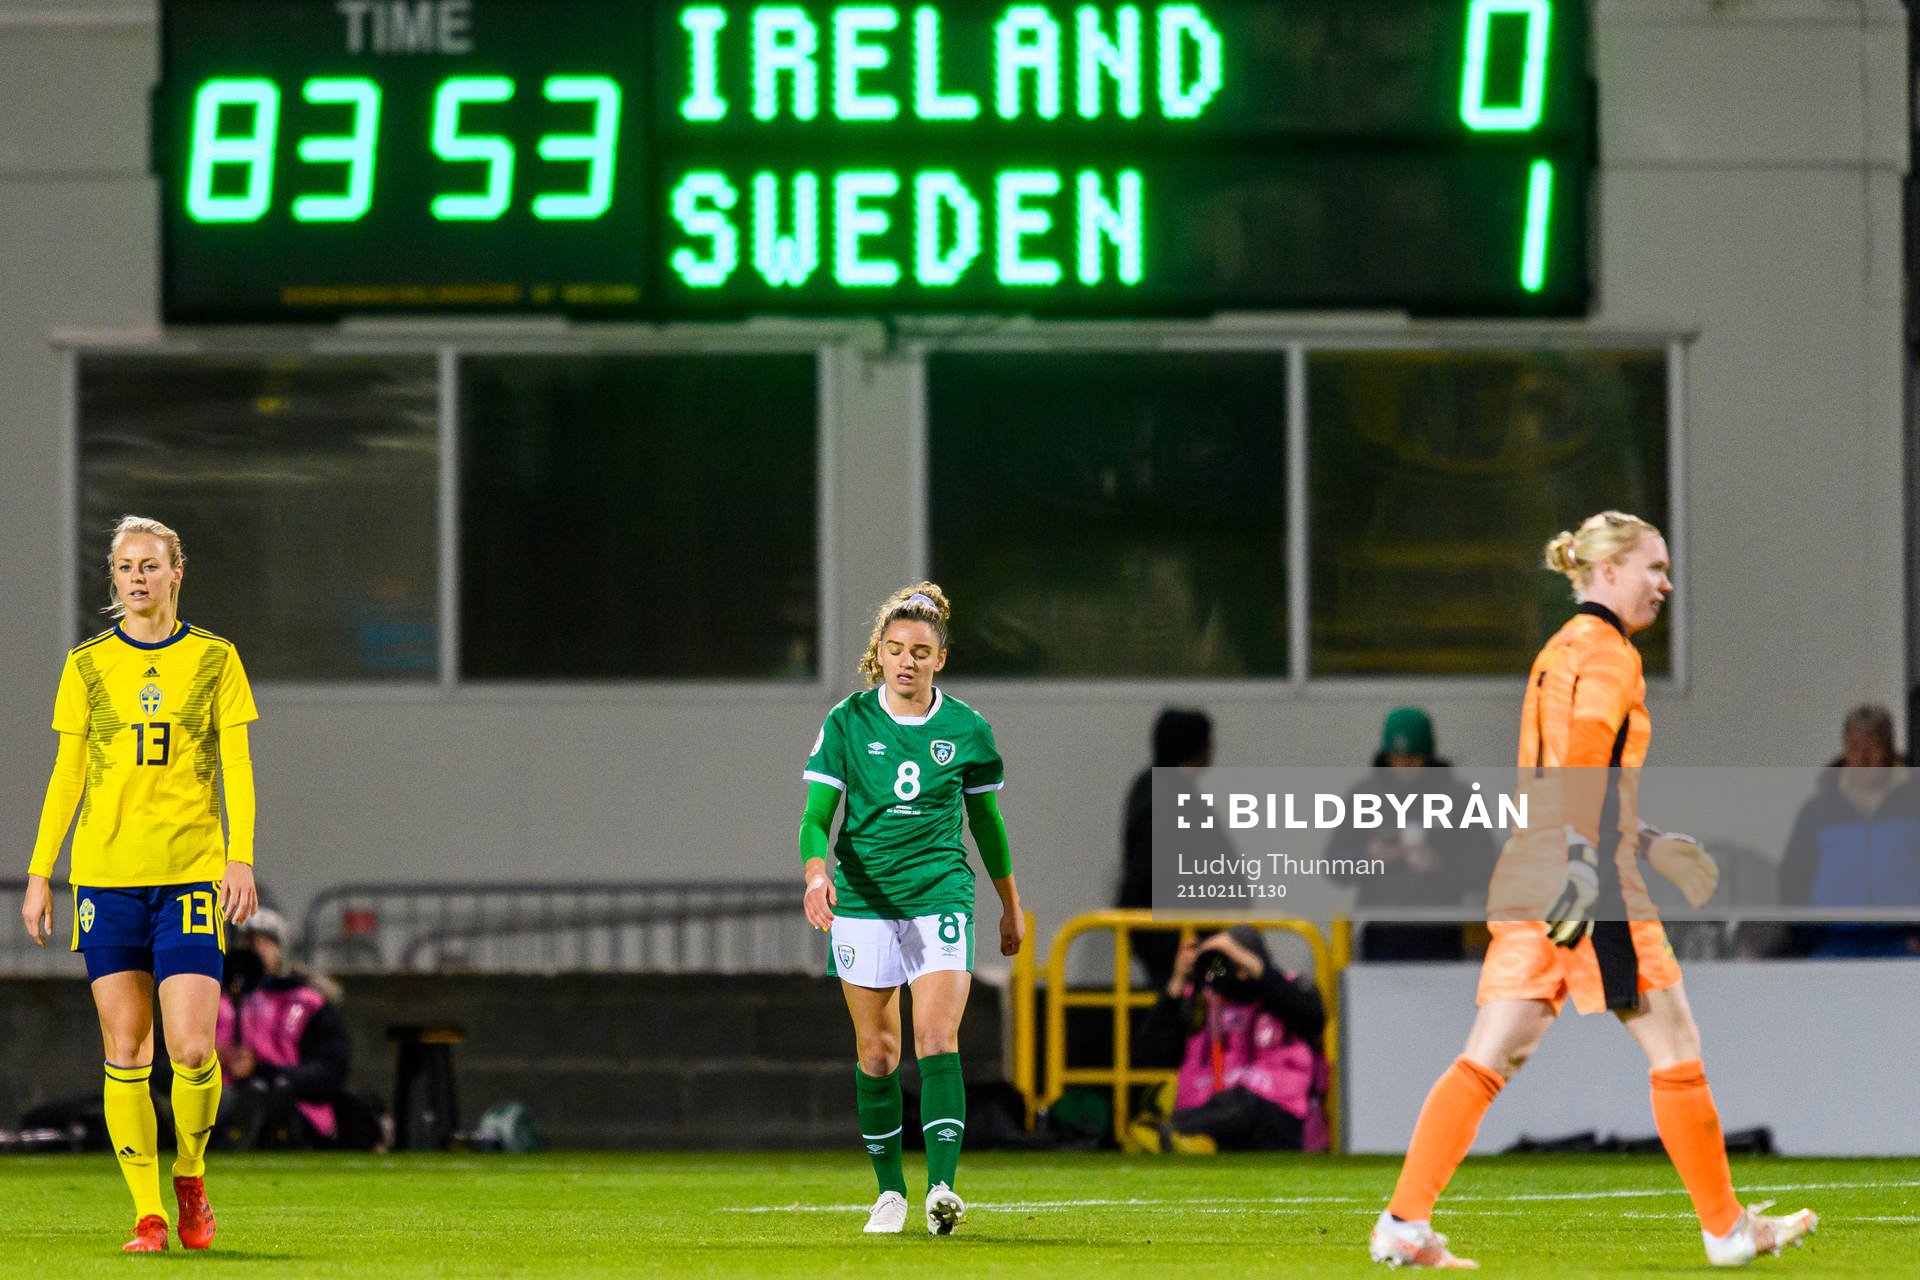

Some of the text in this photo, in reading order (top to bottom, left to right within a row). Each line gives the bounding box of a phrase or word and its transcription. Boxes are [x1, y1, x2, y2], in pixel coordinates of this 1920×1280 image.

[338, 0, 472, 53] TIME
[678, 2, 1225, 122] IRELAND
[1460, 0, 1553, 131] 0
[186, 75, 622, 223] 83 53
[670, 168, 1146, 288] SWEDEN
[1520, 159, 1554, 293] 1
[131, 722, 171, 766] 13
[894, 761, 920, 801] 8
[177, 891, 214, 935] 13
[938, 912, 961, 944] 8
